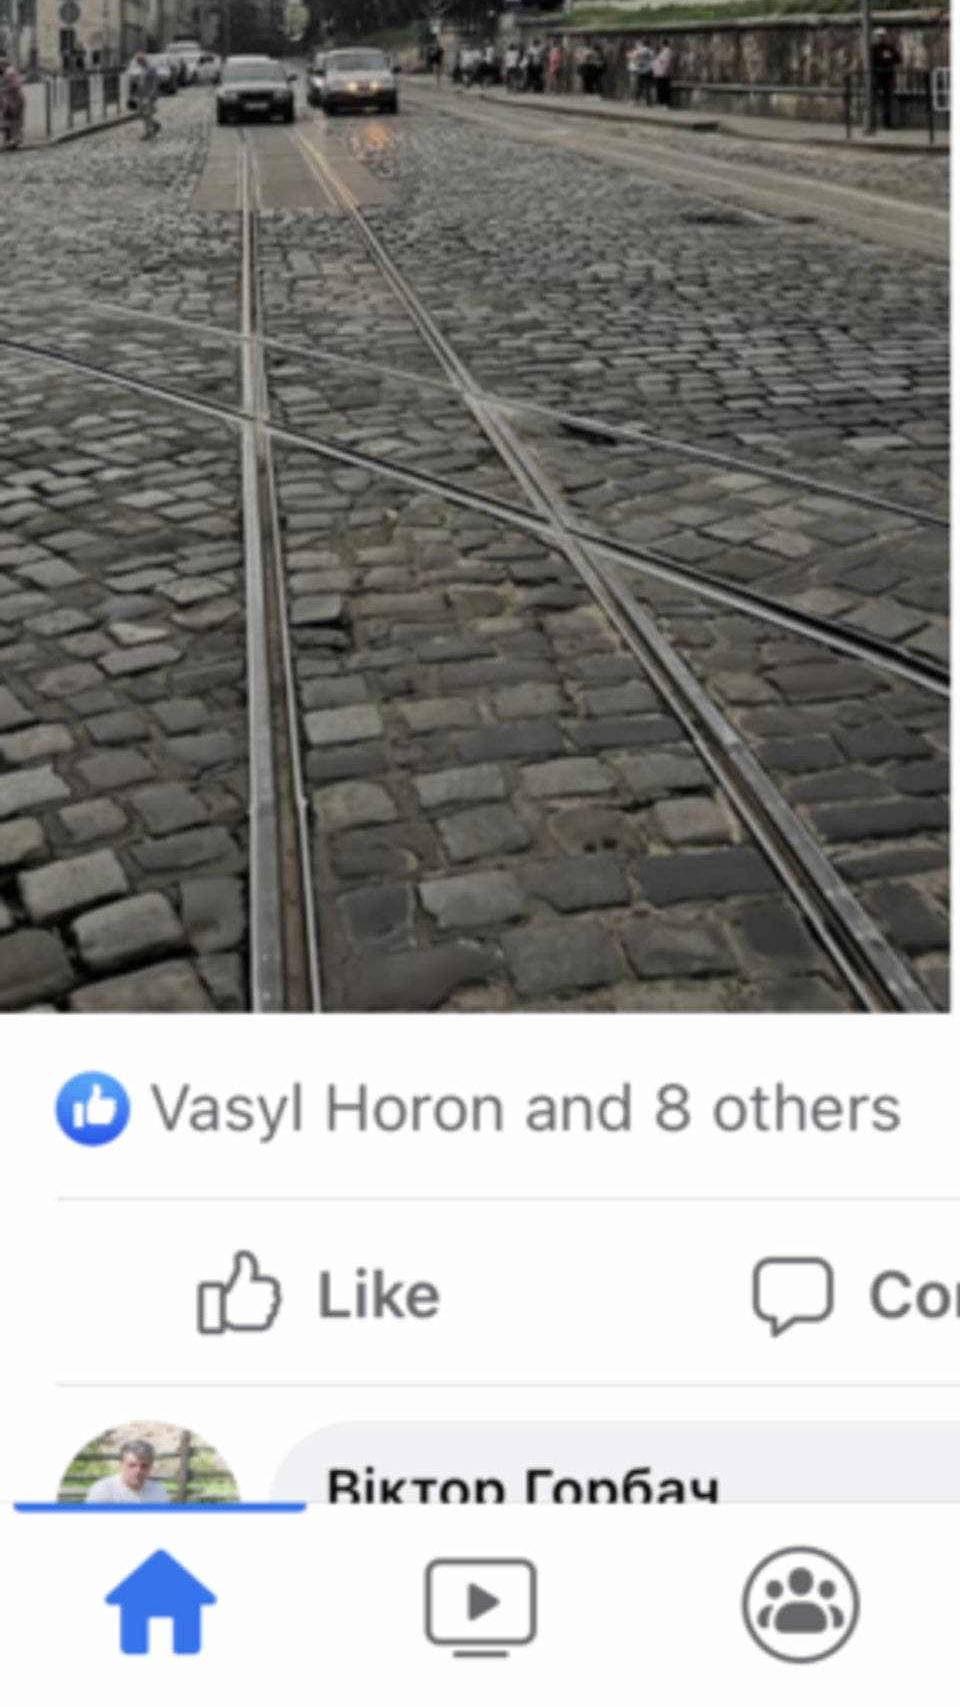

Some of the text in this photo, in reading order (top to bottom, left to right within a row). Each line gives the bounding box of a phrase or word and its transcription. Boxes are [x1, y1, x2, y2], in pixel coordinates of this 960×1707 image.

[149, 1081, 902, 1145] Vasyl Horon and 8 others
[318, 1266, 441, 1320] Like
[327, 1464, 720, 1502] Віктор Горбач
